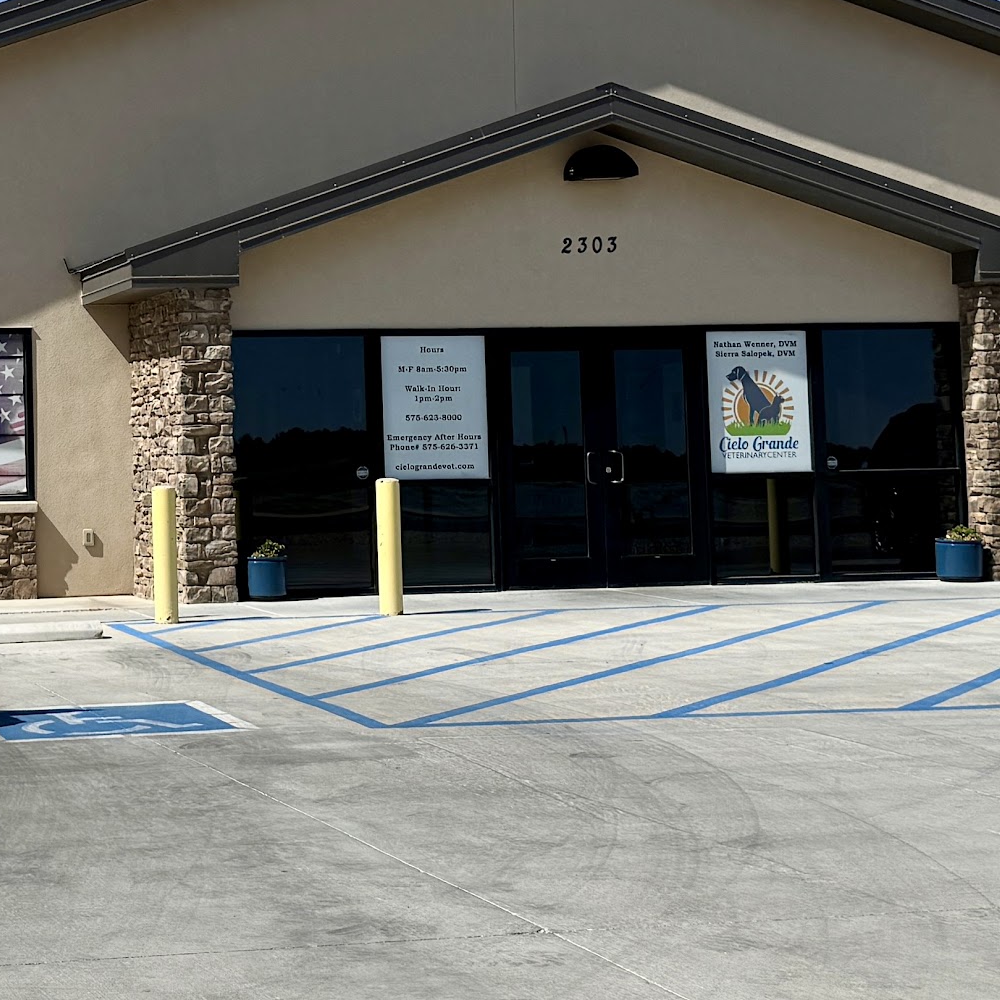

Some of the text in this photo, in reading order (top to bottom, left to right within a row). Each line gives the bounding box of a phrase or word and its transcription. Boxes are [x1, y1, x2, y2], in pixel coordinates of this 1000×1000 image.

[561, 236, 617, 254] 2303
[743, 340, 776, 349] Wenner,
[778, 340, 797, 348] DVM
[420, 346, 445, 354] Hours
[715, 350, 739, 358] Sierra
[741, 350, 775, 359] Salopek,
[416, 365, 467, 374] 8am-5:30pm
[404, 385, 436, 393] Walk-In
[414, 395, 453, 403] 1pm-2pm
[405, 414, 463, 422] 575-623-8000
[387, 433, 482, 443] Emergency After Hours
[390, 443, 479, 451] Phone# 575-626-3371
[719, 436, 799, 453] Cielo Grande
[395, 463, 475, 472] cielograndevet.com
